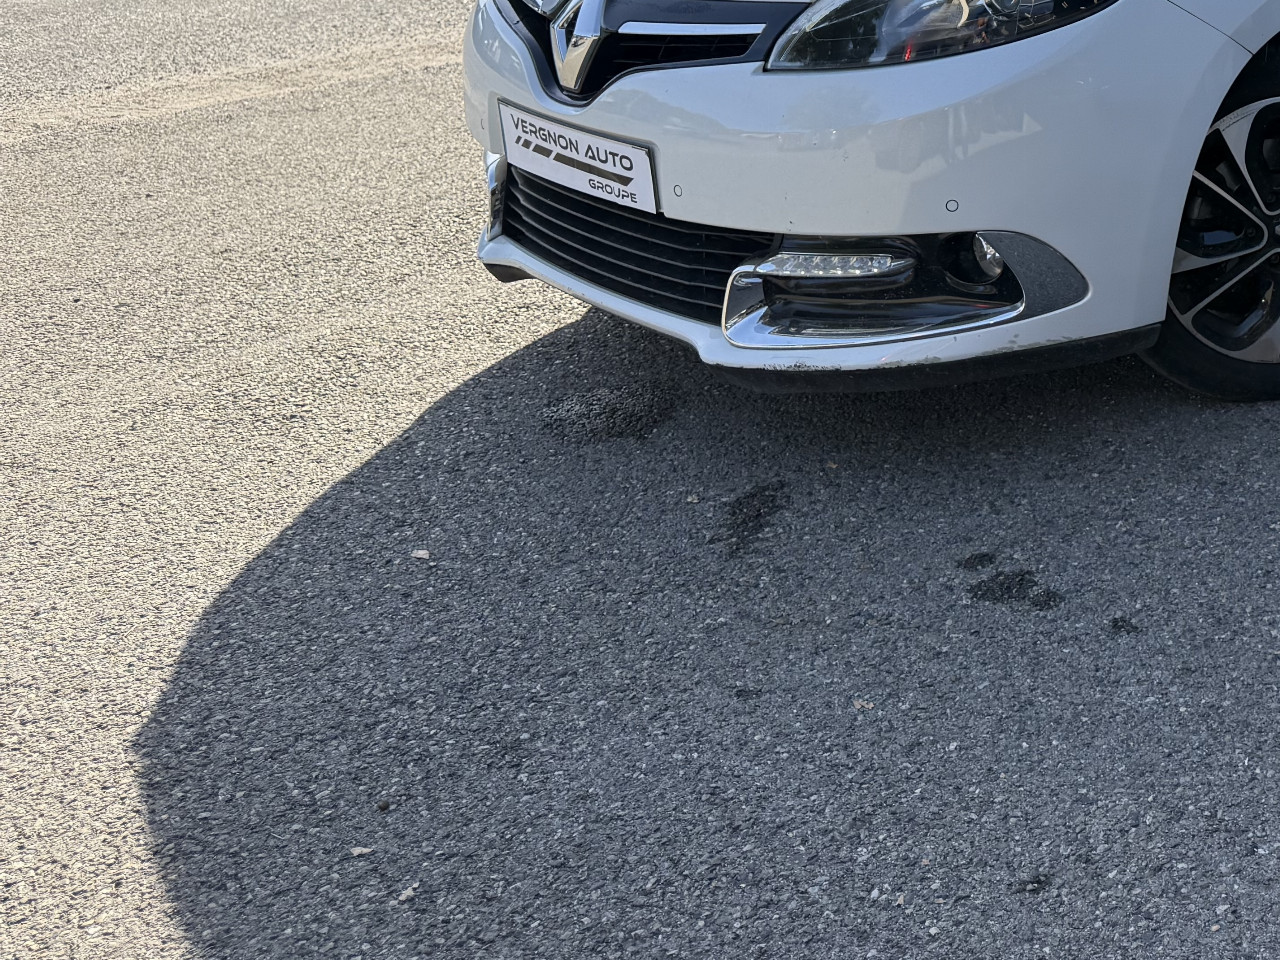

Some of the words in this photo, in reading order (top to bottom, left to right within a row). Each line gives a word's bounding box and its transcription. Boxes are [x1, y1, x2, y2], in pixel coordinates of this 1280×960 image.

[510, 113, 580, 154] VERGNON
[584, 144, 634, 171] AUTO
[588, 178, 638, 203] GROUPE
